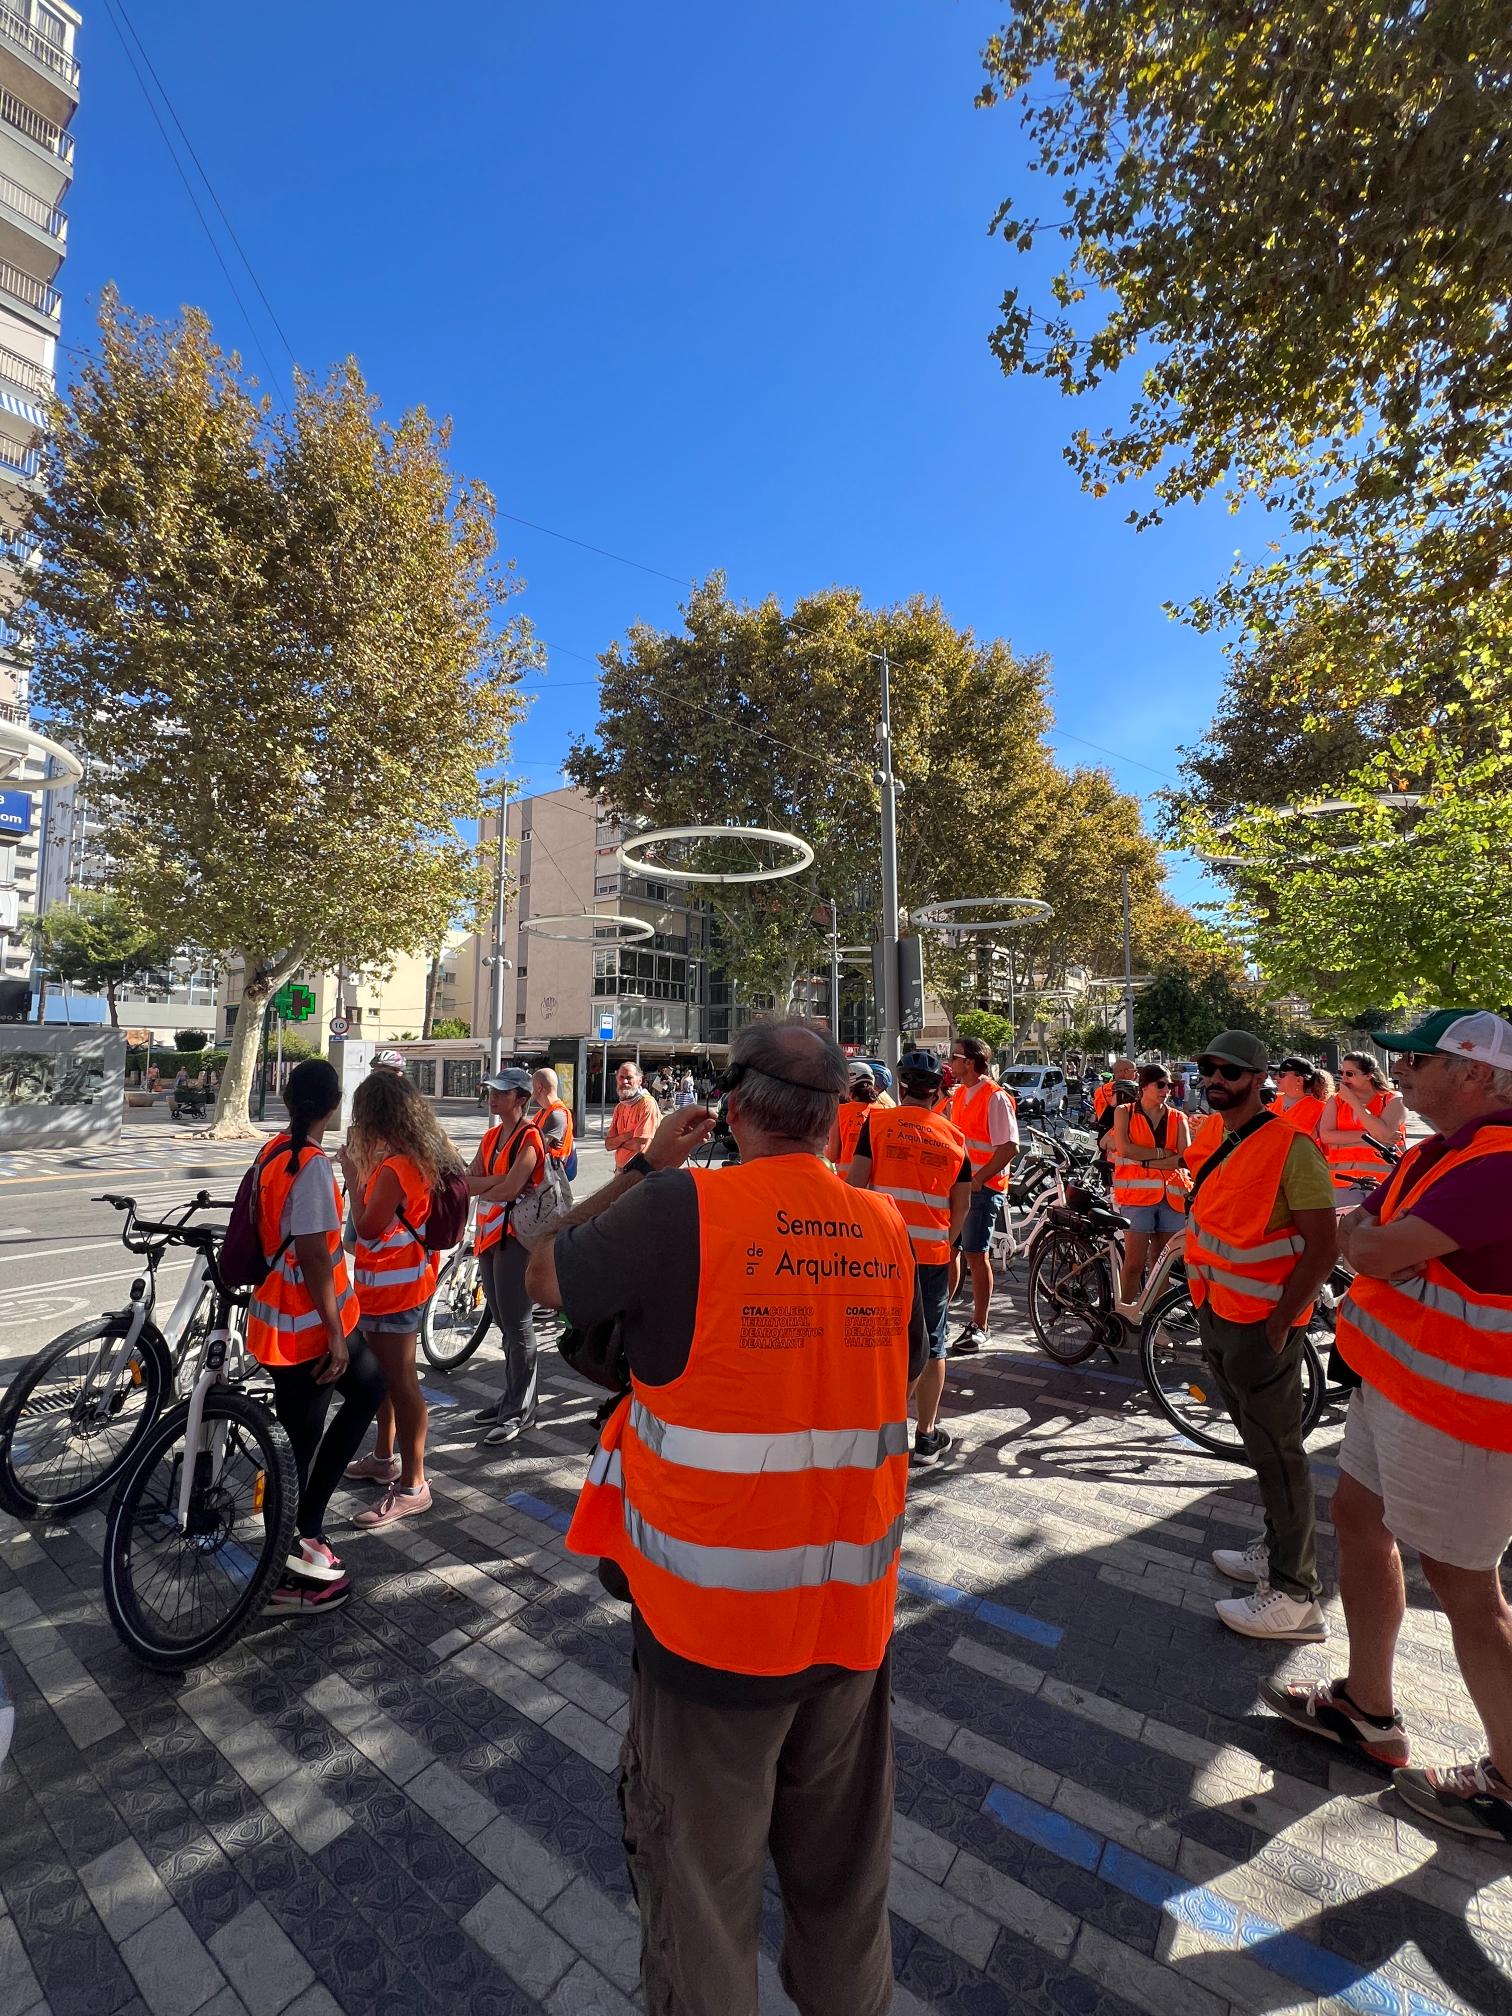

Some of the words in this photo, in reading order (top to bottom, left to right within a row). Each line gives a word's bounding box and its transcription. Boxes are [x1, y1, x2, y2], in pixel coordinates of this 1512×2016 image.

[897, 1118, 932, 1133] Semana
[776, 1209, 864, 1238] Semana
[747, 1243, 764, 1257] de
